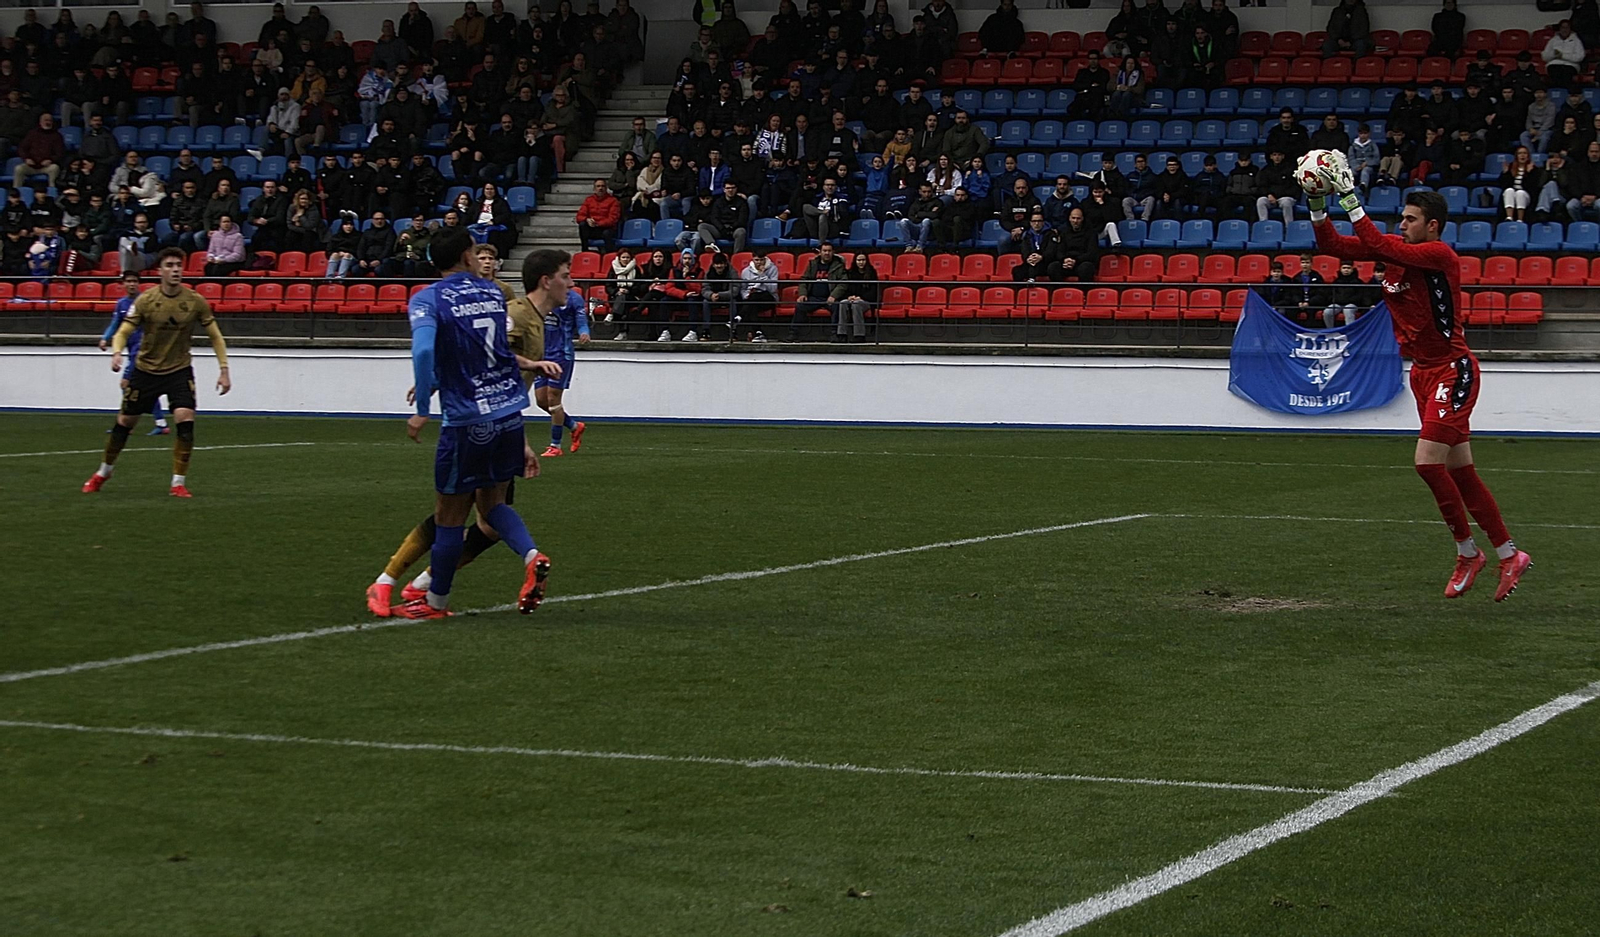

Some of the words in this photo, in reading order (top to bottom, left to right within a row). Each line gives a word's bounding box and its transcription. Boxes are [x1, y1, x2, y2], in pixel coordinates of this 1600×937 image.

[451, 301, 505, 317] CARBONELL
[472, 317, 497, 368] 7
[1289, 393, 1324, 407] DESDE
[1326, 391, 1351, 407] 1977
